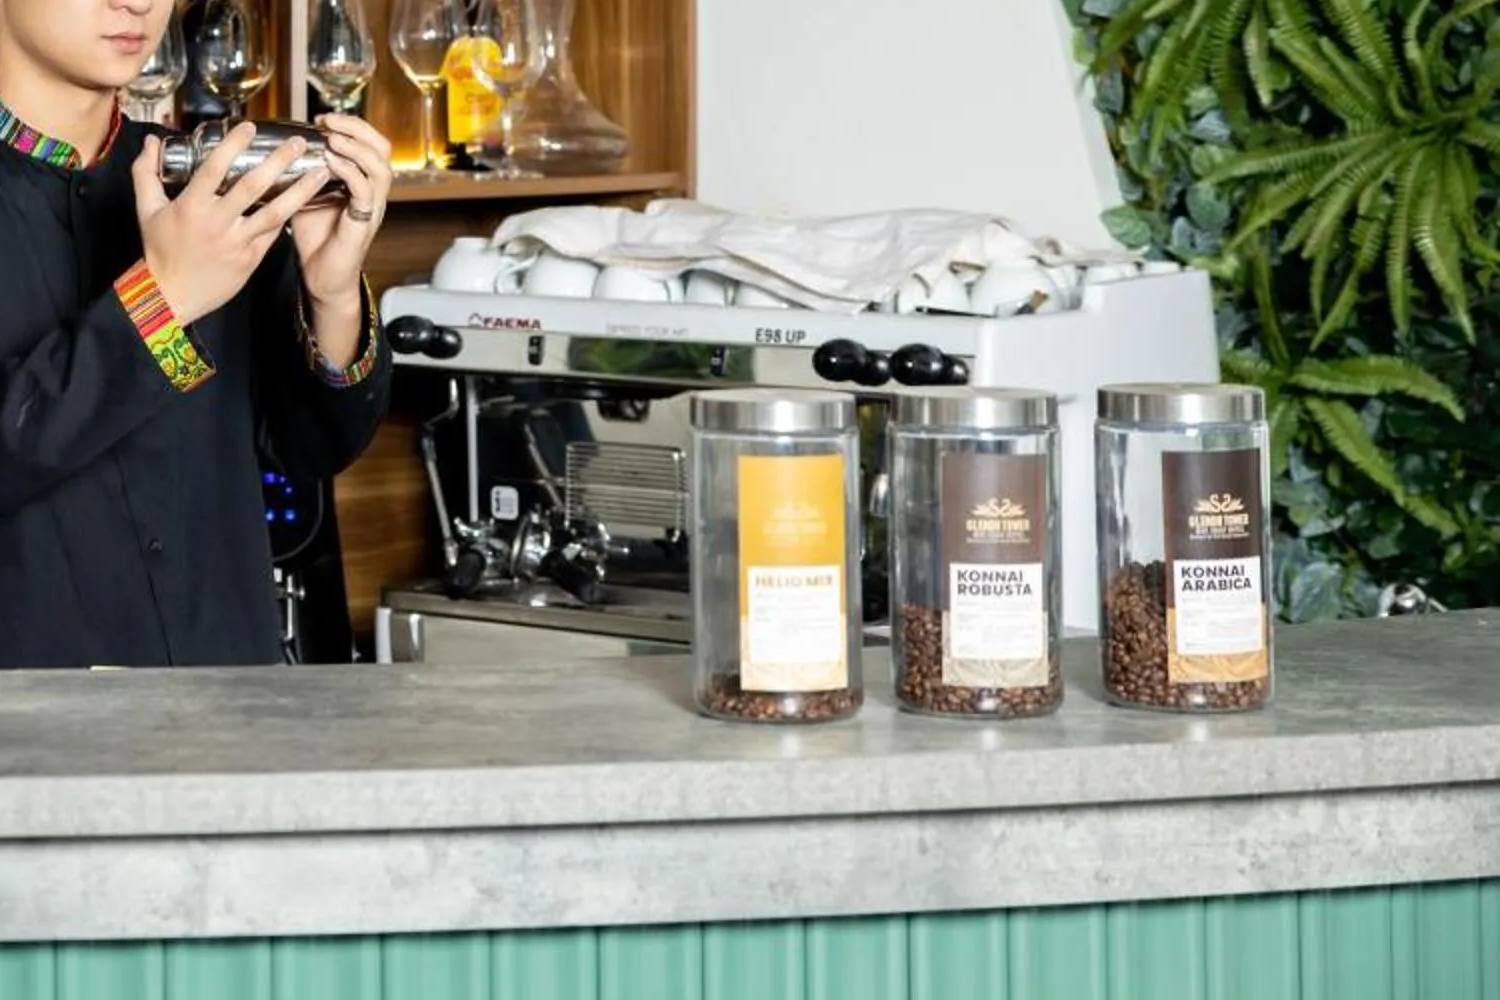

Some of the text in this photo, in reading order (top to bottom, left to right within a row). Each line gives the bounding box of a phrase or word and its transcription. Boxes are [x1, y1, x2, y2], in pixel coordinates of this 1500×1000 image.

[482, 316, 541, 330] FAEMA
[785, 329, 806, 344] UP
[957, 570, 1023, 583] KONNAI
[1181, 565, 1245, 579] KONNAI
[957, 583, 1032, 596] ROBUSTA
[1182, 577, 1252, 591] ARABICA
